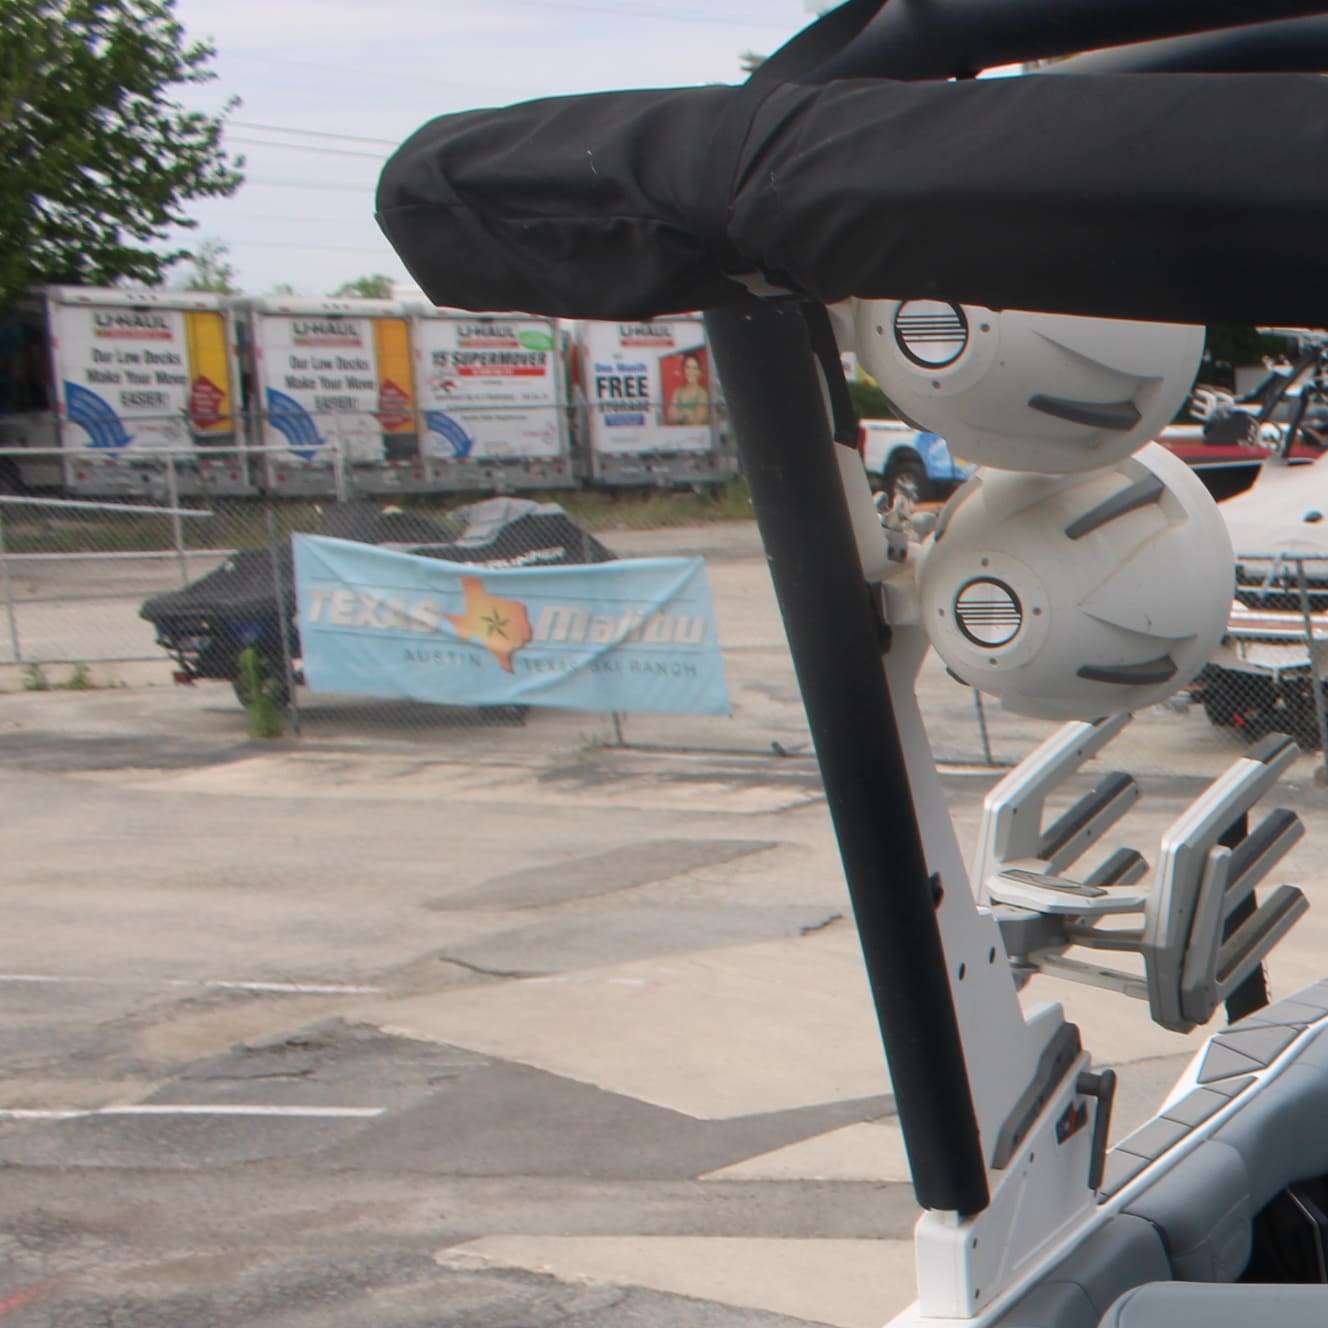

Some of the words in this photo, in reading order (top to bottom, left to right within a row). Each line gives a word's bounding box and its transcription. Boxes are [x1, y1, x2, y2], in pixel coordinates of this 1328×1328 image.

[595, 375, 649, 398] FREE
[307, 590, 444, 633] TEXAS
[537, 605, 709, 645] Malibu
[404, 649, 483, 668] AUSTIN
[629, 660, 698, 677] RANCH
